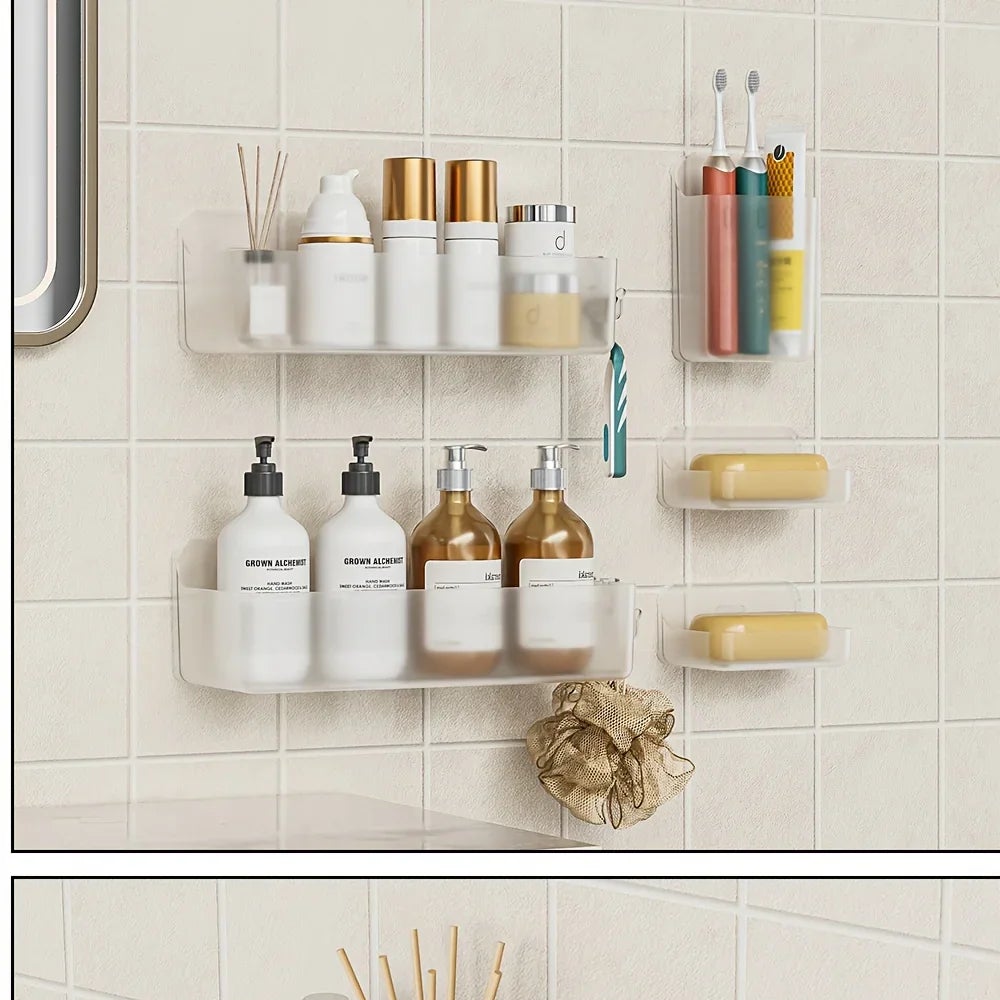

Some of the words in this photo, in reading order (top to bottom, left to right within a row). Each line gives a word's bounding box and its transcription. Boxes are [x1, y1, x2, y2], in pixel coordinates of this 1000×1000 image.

[555, 229, 566, 251] d
[245, 559, 273, 567] GROWN
[343, 557, 371, 565] GROWN
